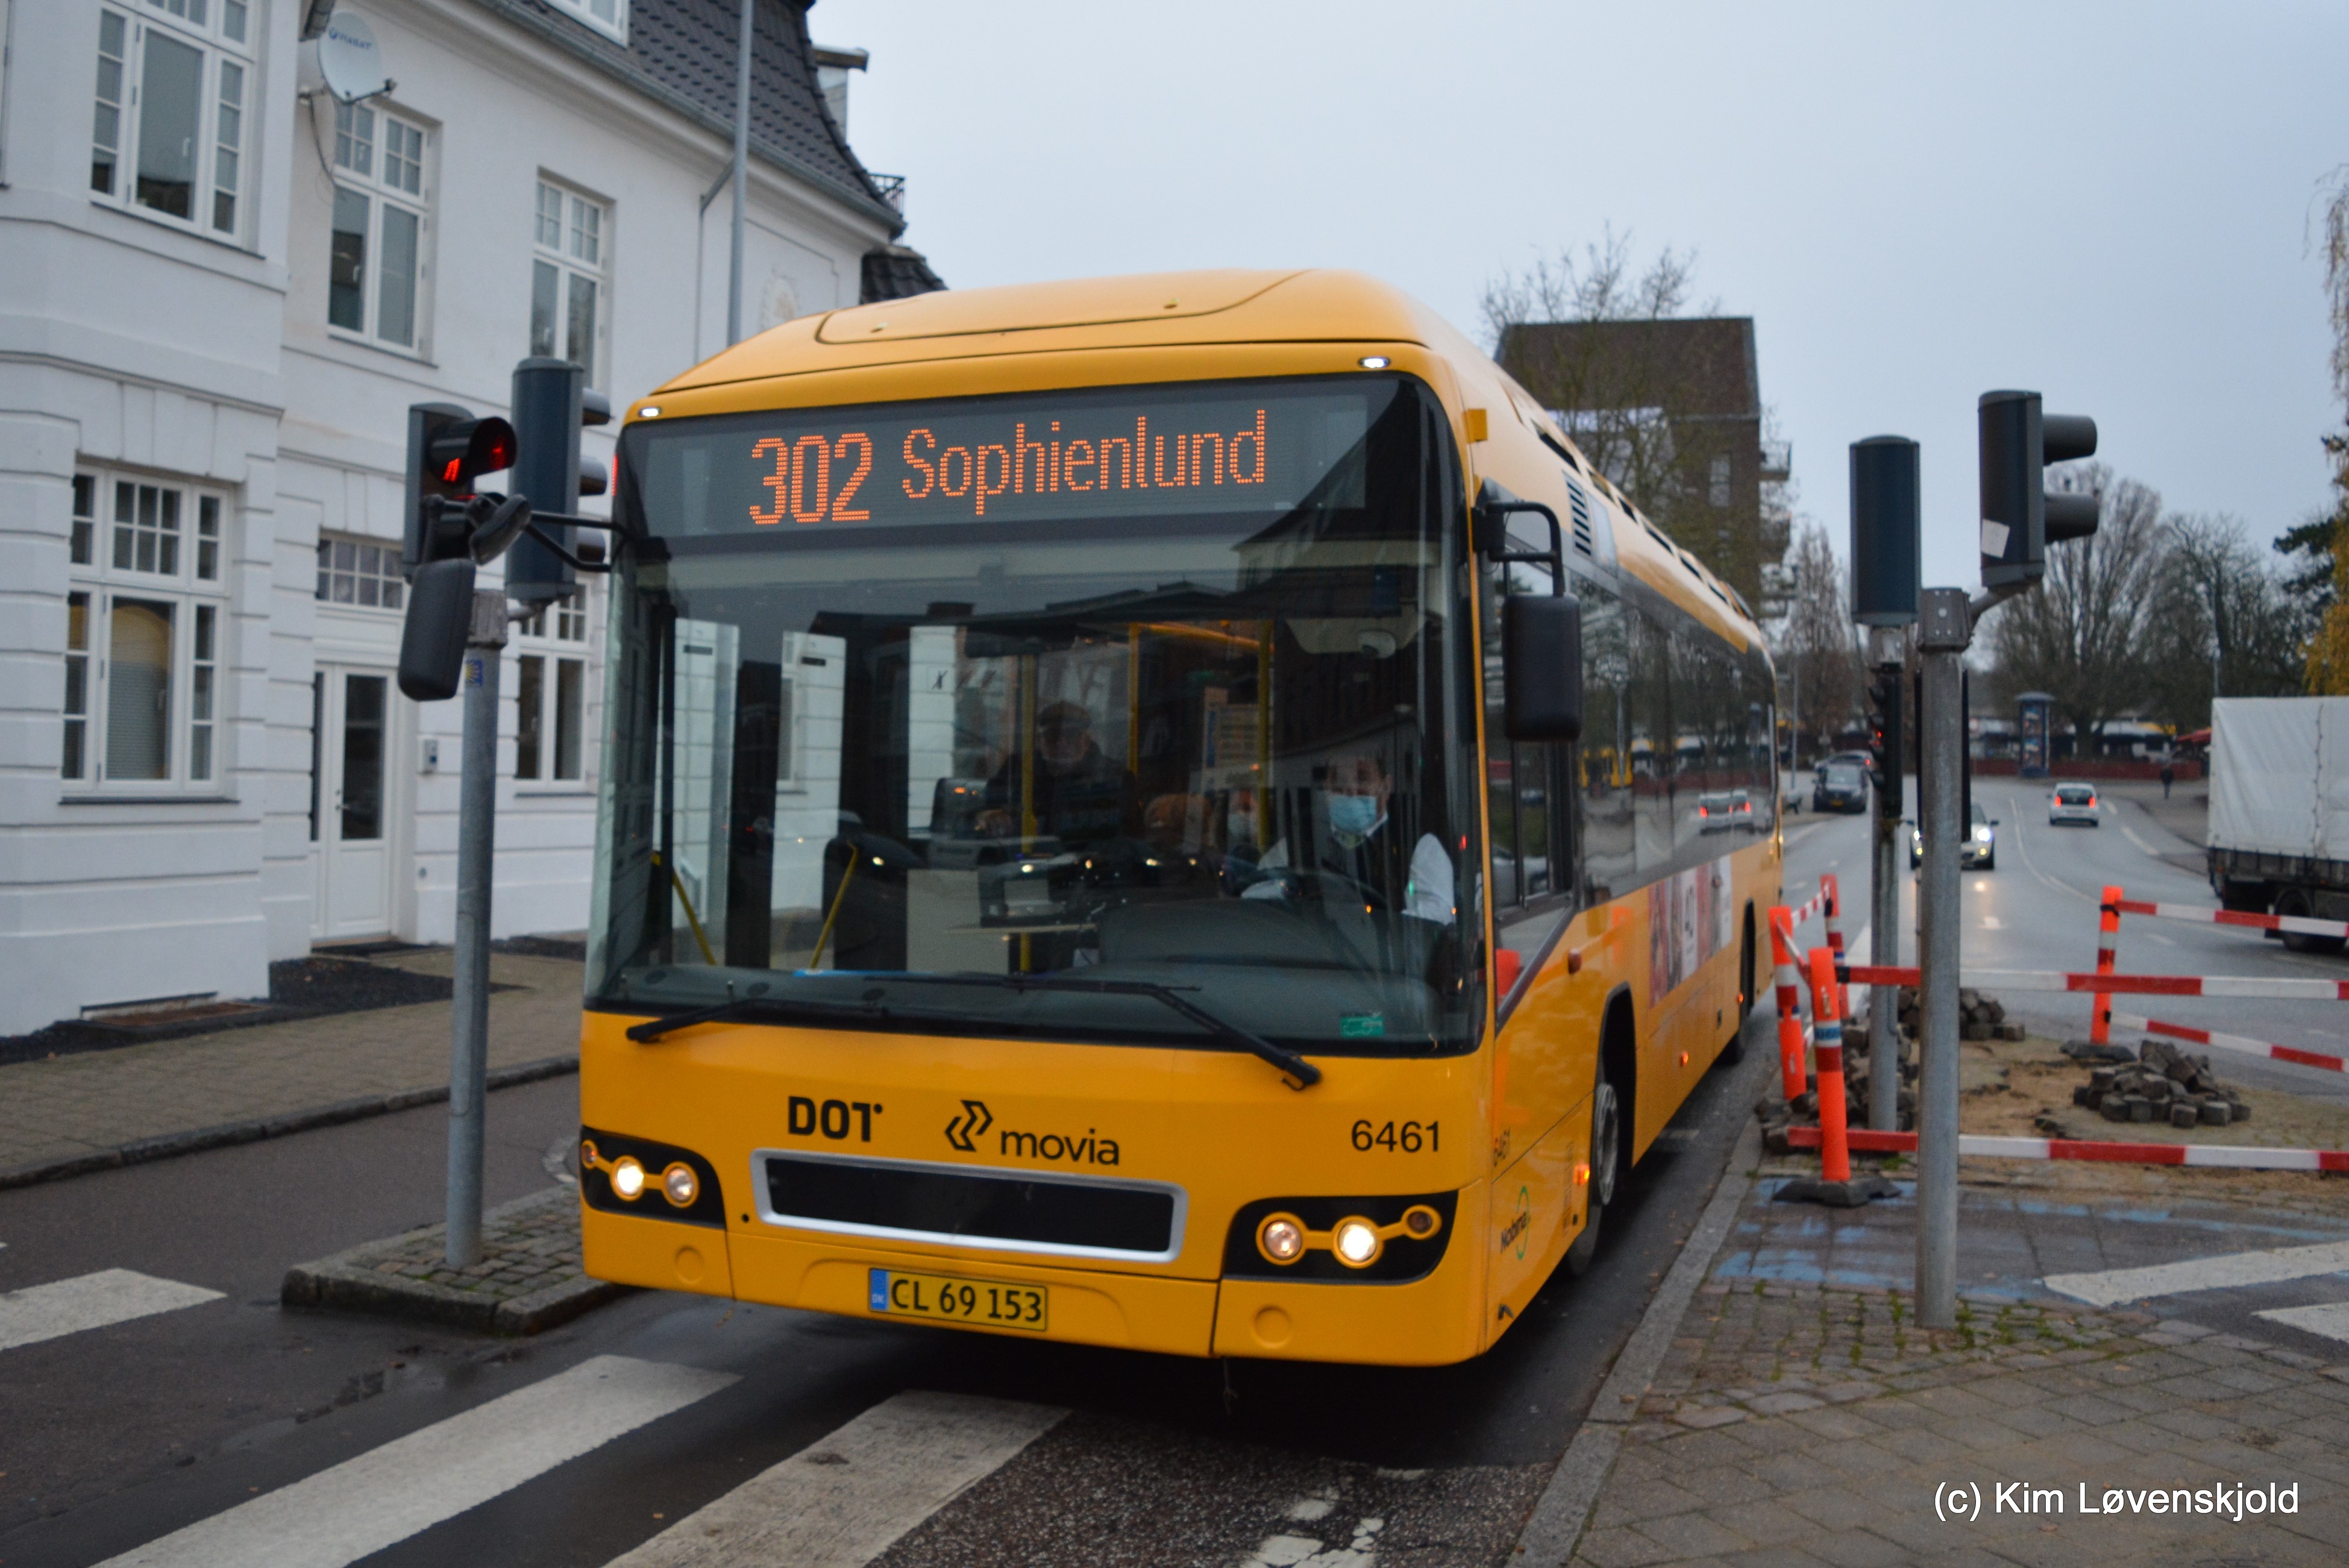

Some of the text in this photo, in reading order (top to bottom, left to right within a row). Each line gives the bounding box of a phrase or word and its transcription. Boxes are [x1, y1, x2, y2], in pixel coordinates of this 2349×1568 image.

[750, 409, 1266, 524] 302 Sophienlund
[788, 1096, 882, 1142] DOT
[1351, 1120, 1439, 1153] 6461
[1000, 1128, 1120, 1165] movia
[891, 1279, 1042, 1323] CL 69 153
